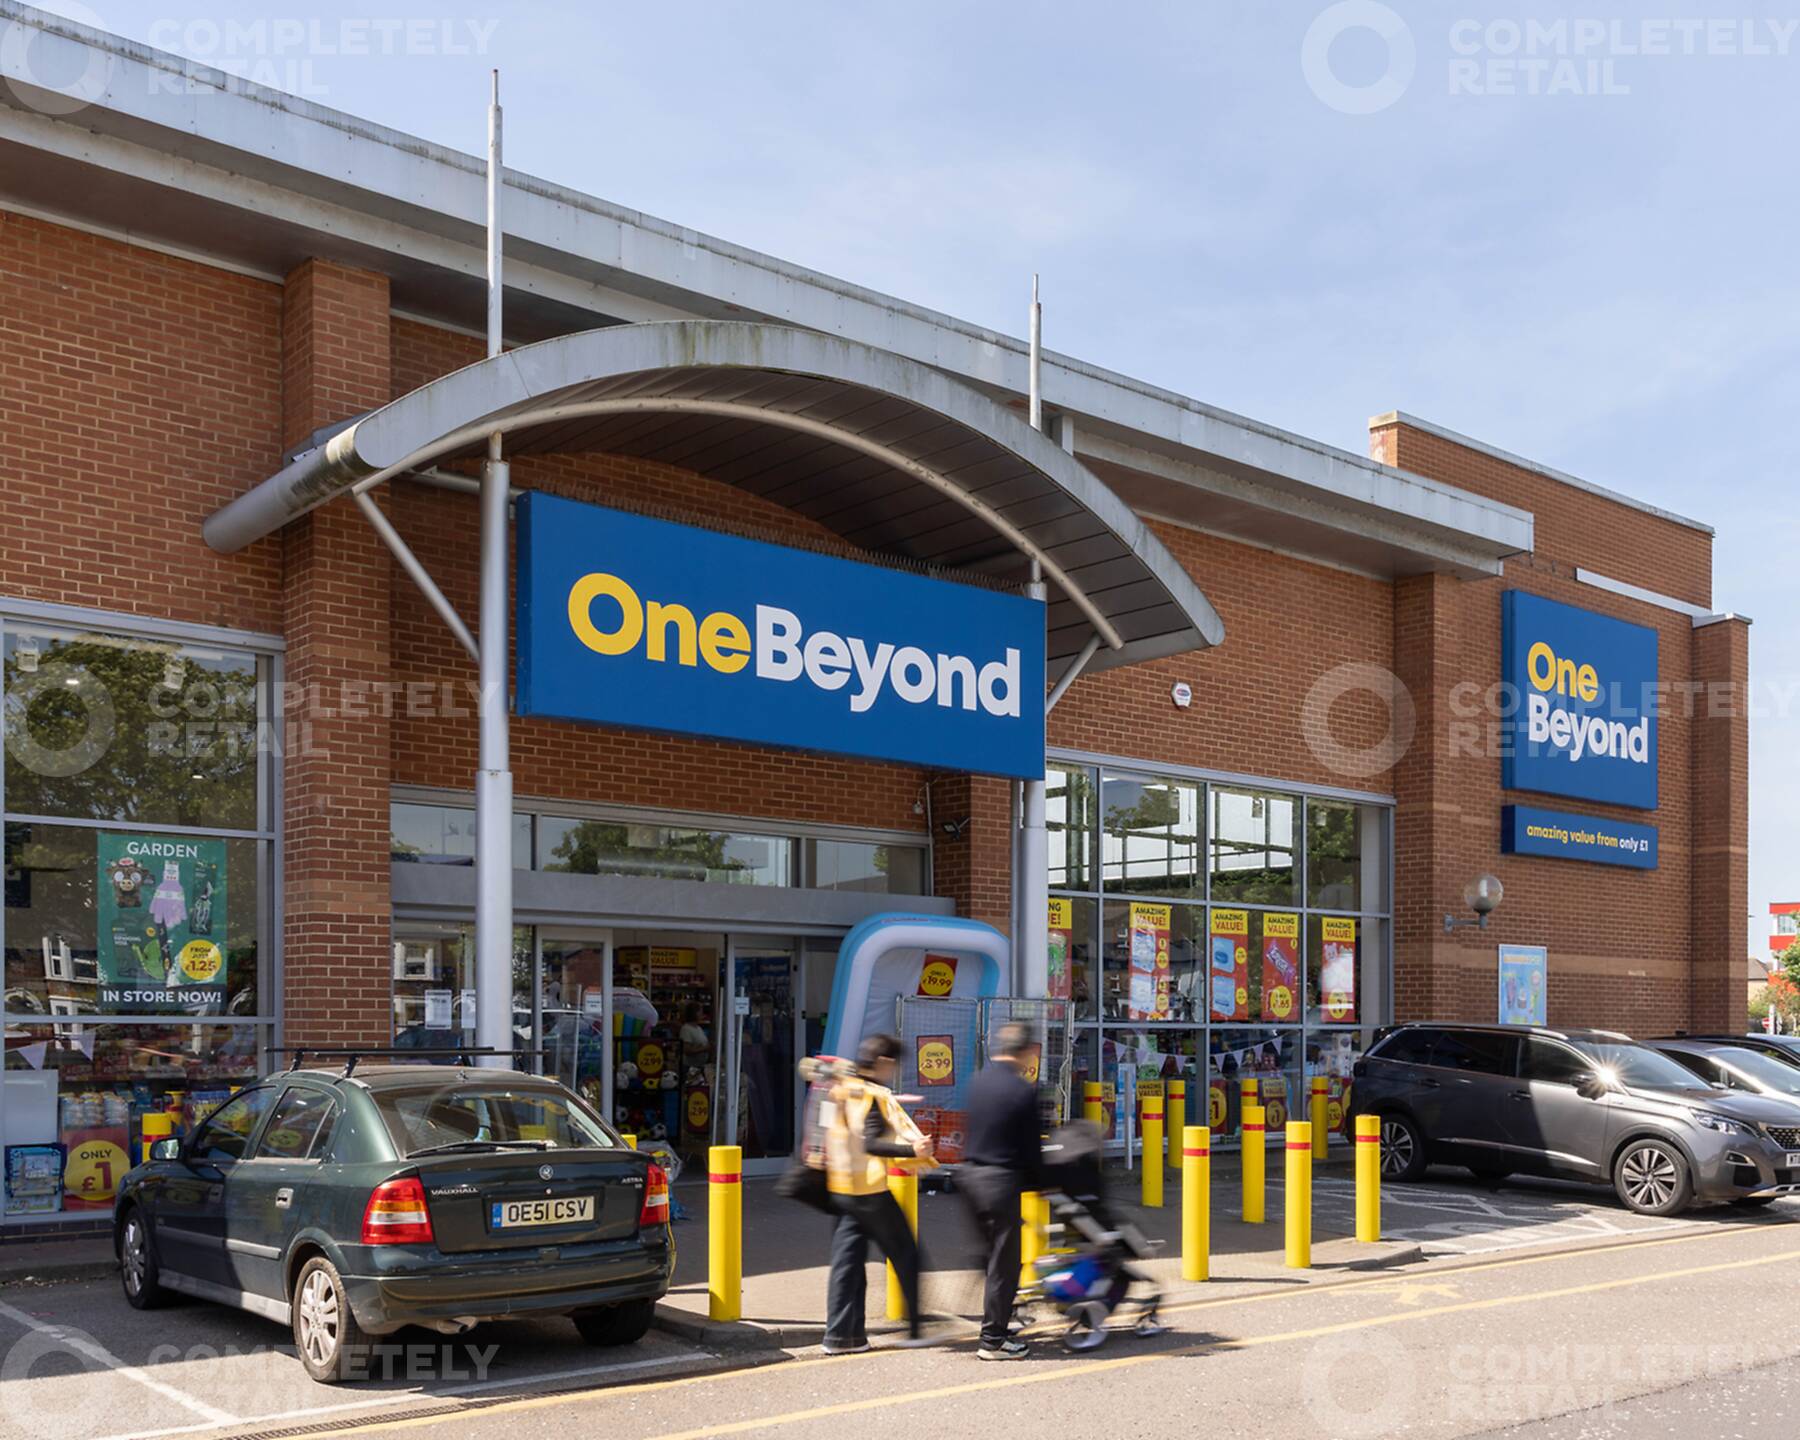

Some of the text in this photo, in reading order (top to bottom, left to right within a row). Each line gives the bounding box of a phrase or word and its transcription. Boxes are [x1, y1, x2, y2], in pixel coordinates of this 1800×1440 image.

[1527, 641, 1598, 702] One
[1528, 693, 1648, 763] Beyond
[1527, 824, 1648, 852] amazing value from only £1
[127, 841, 198, 858] GARDEN
[1135, 906, 1166, 915] AMAZING
[1136, 914, 1166, 926] VALUE!
[1215, 913, 1243, 921] AMAZING
[1268, 917, 1295, 925] AMAZING
[1215, 921, 1243, 931] VALUE!
[1267, 924, 1295, 934] VALUE!
[1326, 928, 1351, 938] VALUE!
[190, 946, 211, 954] FROM
[185, 960, 217, 972] £1.25
[922, 976, 952, 986] £19.99
[103, 990, 222, 1003] IN STORE NOW!
[80, 1149, 112, 1160] ONLY
[81, 1162, 113, 1192] £1
[431, 1186, 478, 1197] VAUXHALL
[508, 1200, 587, 1222] OE51 CSV
